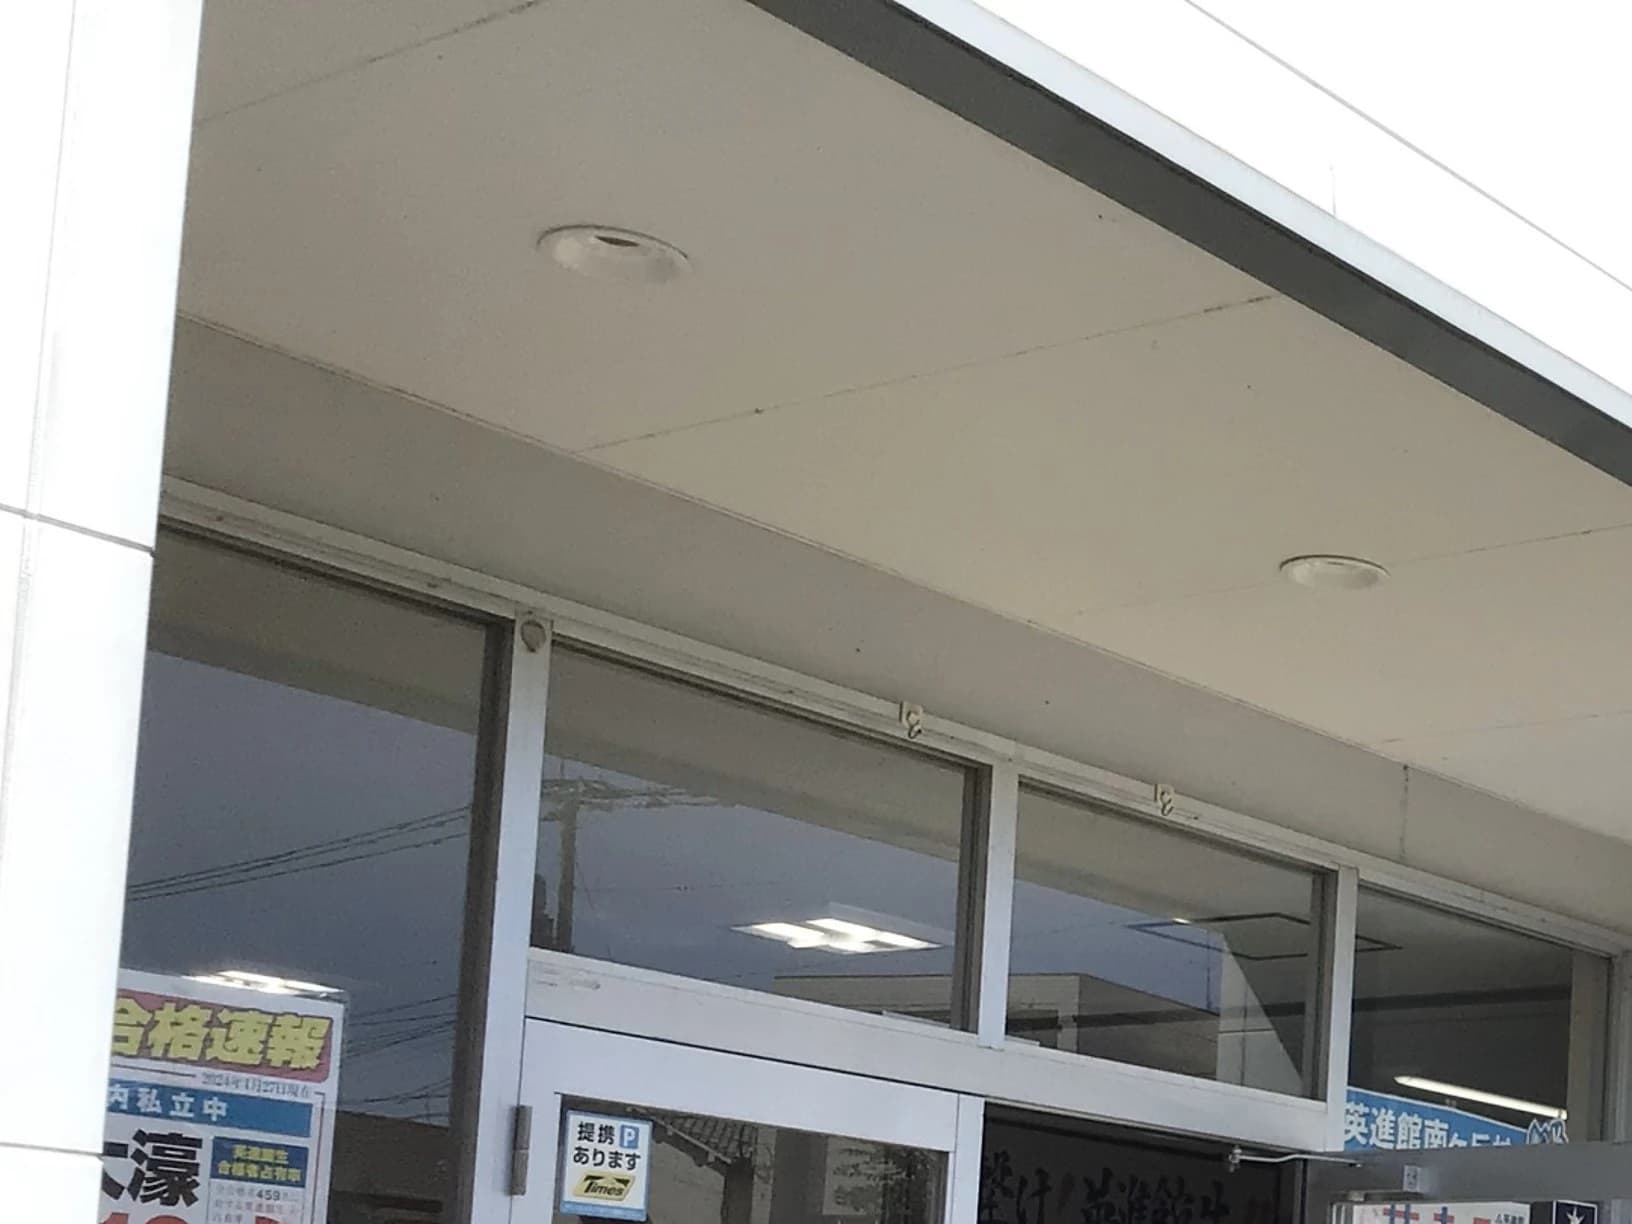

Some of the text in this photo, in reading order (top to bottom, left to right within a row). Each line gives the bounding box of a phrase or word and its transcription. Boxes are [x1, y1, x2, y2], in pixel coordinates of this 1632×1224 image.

[577, 1120, 615, 1145] 提携
[573, 1146, 642, 1171] あります
[584, 1175, 626, 1196] Times
